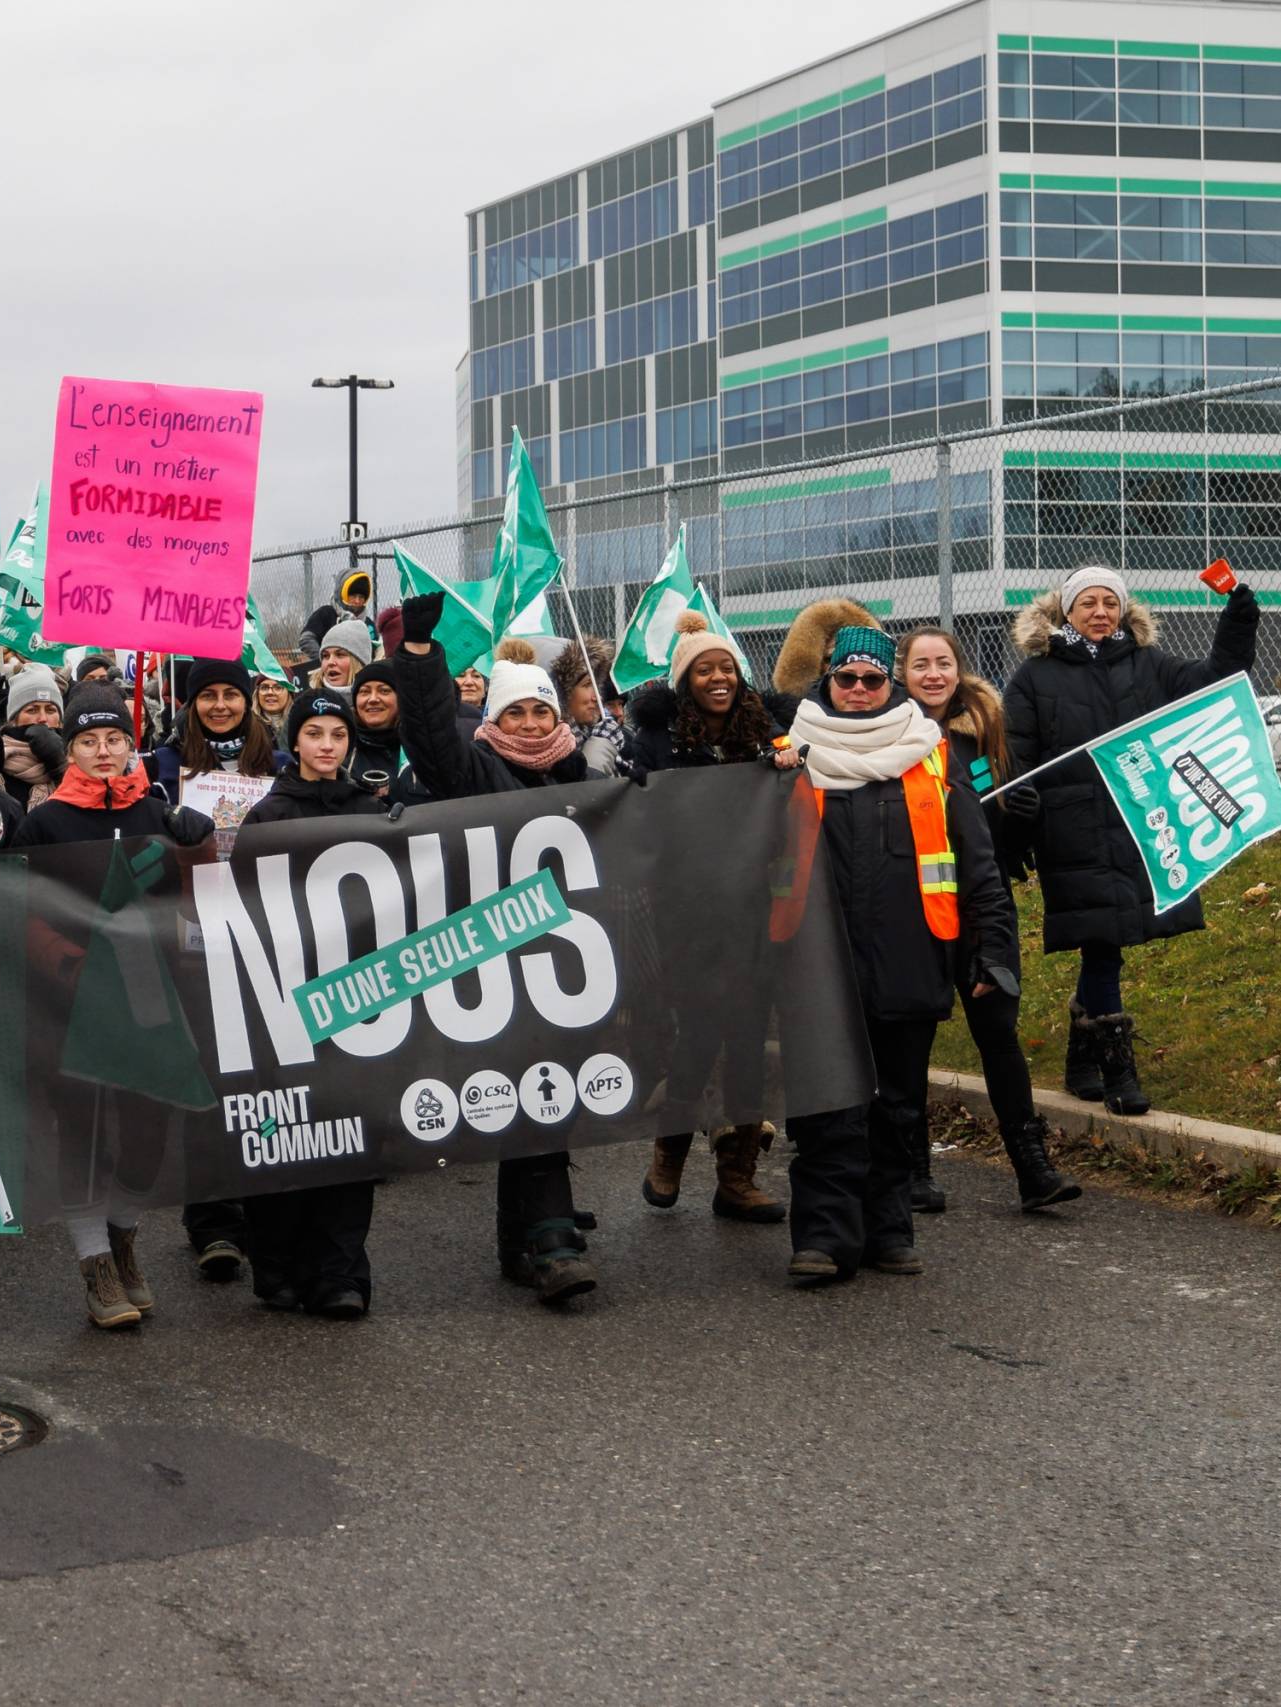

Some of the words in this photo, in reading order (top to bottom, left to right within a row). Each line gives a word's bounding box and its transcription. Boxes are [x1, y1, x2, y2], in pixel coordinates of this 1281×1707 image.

[70, 386, 258, 448] L'enseignement
[75, 444, 100, 468] est
[115, 459, 141, 476] un
[154, 456, 219, 482] métier
[69, 477, 222, 522] FORMIDABLE
[66, 529, 105, 545] avec
[127, 528, 152, 549] des
[164, 534, 230, 566] moyens
[140, 585, 245, 630] MINABLES
[1214, 793, 1239, 823] VOIX
[192, 815, 617, 1073] NOUS
[307, 961, 397, 1030] D'UNE
[399, 918, 484, 985] SEULE
[489, 883, 556, 942] VOIX
[484, 1084, 511, 1098] CSQ
[585, 1077, 622, 1093] APTS
[223, 1086, 310, 1132] FRONT
[417, 1117, 445, 1131] CSN
[540, 1105, 560, 1117] FTQ
[242, 1116, 365, 1168] COMMUN
